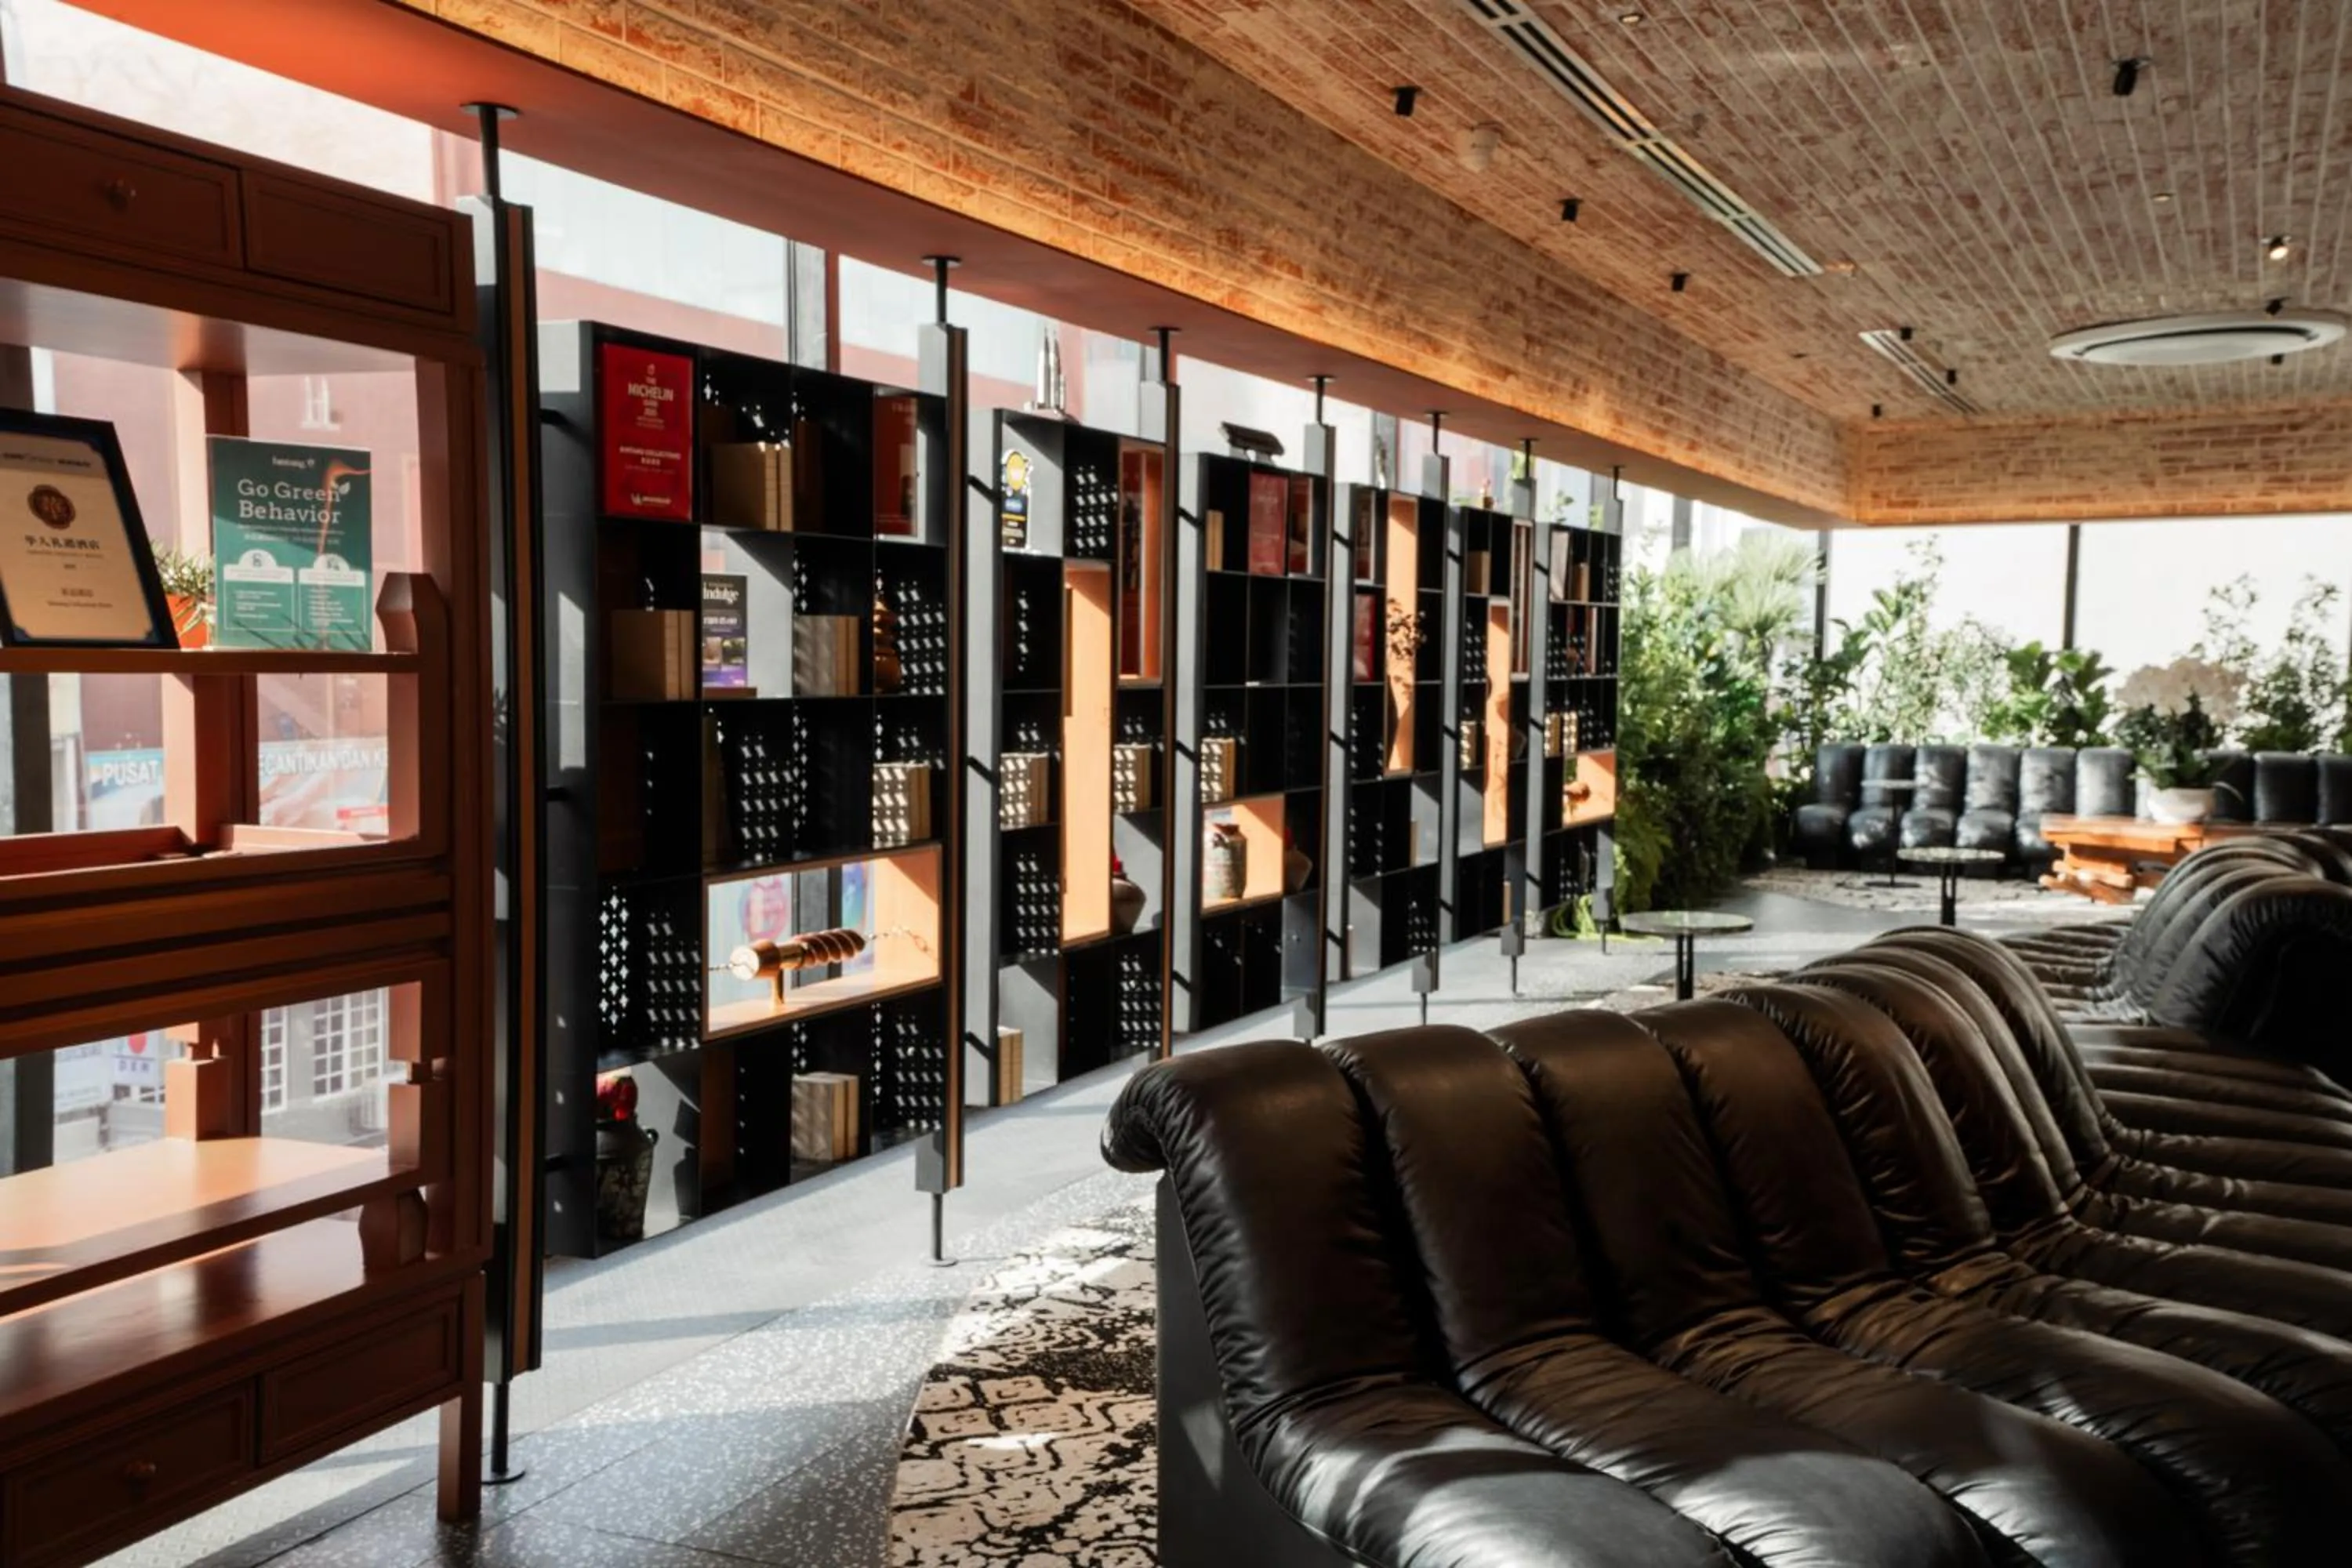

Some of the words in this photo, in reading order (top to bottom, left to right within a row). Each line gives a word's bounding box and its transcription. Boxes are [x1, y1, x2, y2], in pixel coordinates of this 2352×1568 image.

[627, 382, 674, 402] MICHELIN
[238, 478, 269, 498] Go
[274, 481, 341, 503] Green
[238, 499, 343, 524] Behavior
[702, 581, 741, 605] Indulge
[101, 759, 160, 787] PUSAT
